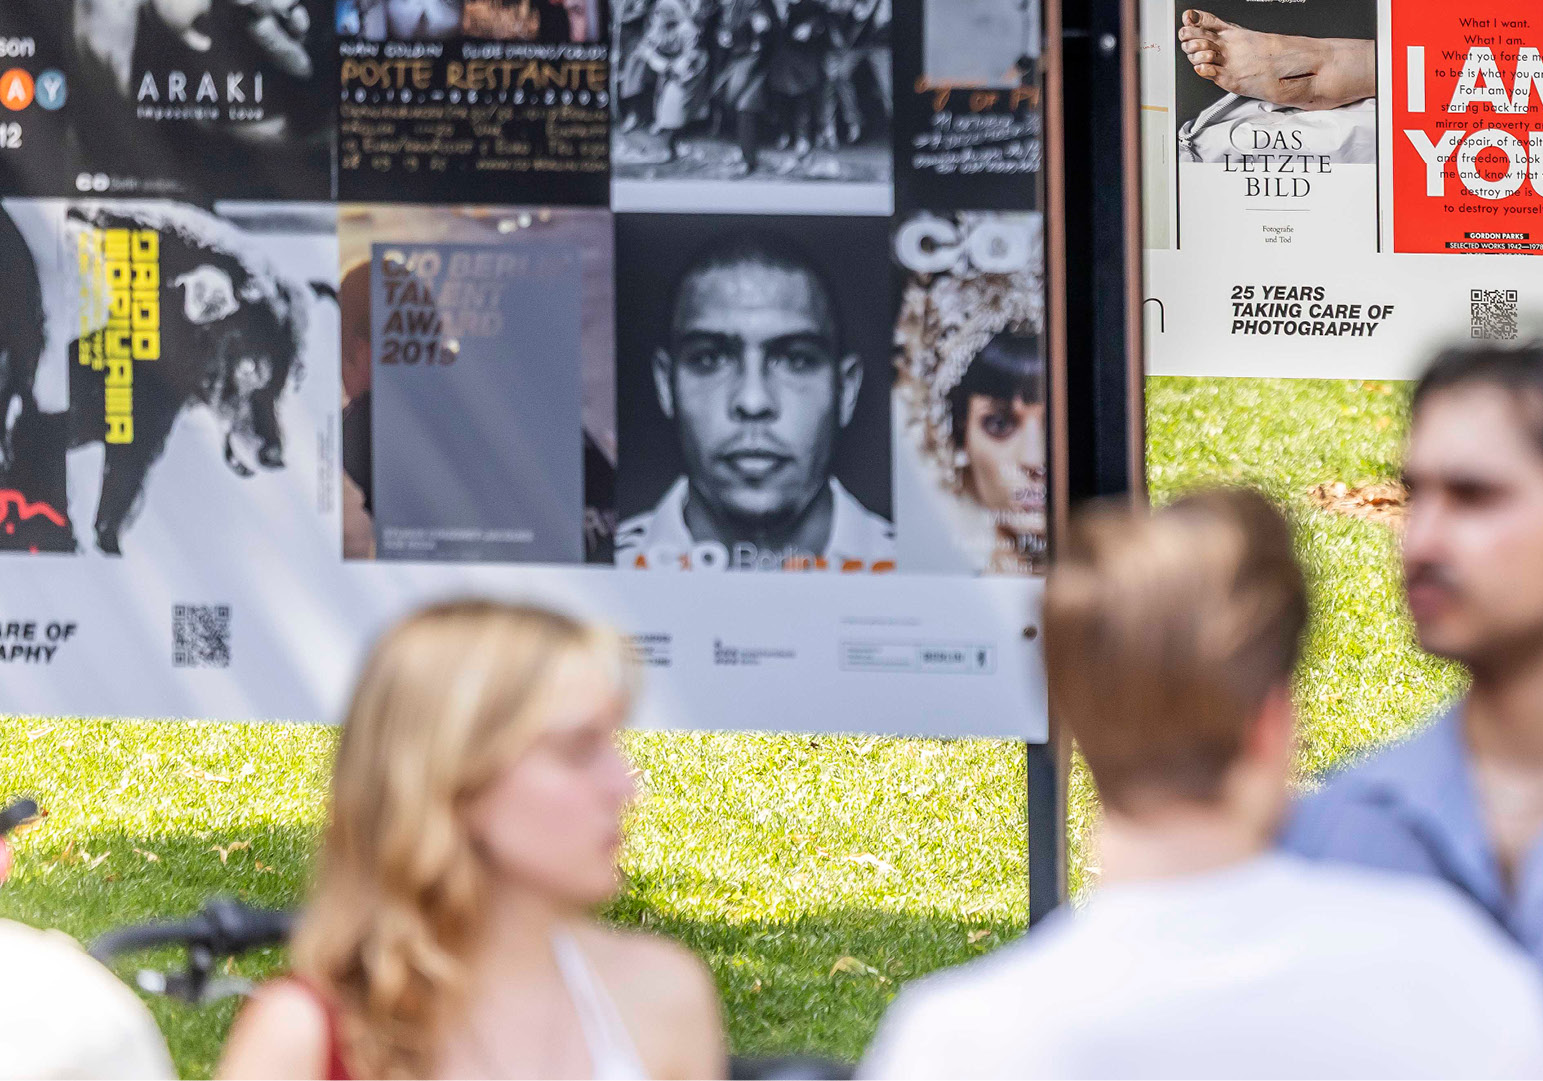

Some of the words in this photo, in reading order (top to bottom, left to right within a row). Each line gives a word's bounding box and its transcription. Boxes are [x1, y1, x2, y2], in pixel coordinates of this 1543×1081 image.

[1459, 17, 1490, 28] What
[1501, 19, 1530, 29] want.
[1463, 35, 1495, 45] What
[1505, 37, 1526, 45] am.
[1441, 50, 1473, 61] What
[1477, 53, 1496, 64] you
[1500, 51, 1528, 62] force
[341, 58, 433, 89] POSTE
[446, 60, 609, 91] RESTANTE
[1406, 45, 1426, 113] I
[1435, 68, 1447, 78] to
[1450, 67, 1464, 78] be
[1481, 68, 1506, 79] what
[1510, 71, 1530, 81] you
[137, 70, 264, 103] ARAKI
[1459, 84, 1477, 95] For
[1487, 88, 1505, 96] am
[1441, 102, 1479, 114] staring
[1483, 102, 1510, 113] back
[1513, 102, 1539, 113] from
[1435, 119, 1469, 129] mirror
[1472, 119, 1484, 129] of
[1488, 120, 1530, 131] poverty
[1251, 129, 1302, 151] DAS
[1448, 135, 1493, 148] despair,
[1512, 136, 1543, 147] revolt
[1223, 154, 1332, 174] LETZTE
[1436, 153, 1458, 164] and
[1461, 153, 1511, 164] freedom.
[1515, 154, 1541, 164] Look
[1439, 171, 1456, 179] me
[1460, 170, 1481, 179] and
[1484, 169, 1513, 180] know
[1516, 170, 1538, 180] that
[1244, 177, 1311, 198] BILD
[1460, 186, 1501, 198] destroy
[1505, 189, 1521, 197] me
[1458, 203, 1499, 215] destroy
[1262, 225, 1294, 235] Fotografie
[1265, 235, 1277, 243] und
[1277, 235, 1292, 244] Tod
[1480, 242, 1506, 250] WORKS
[1231, 285, 1255, 300] 25
[1261, 286, 1326, 302] YEARS
[1232, 302, 1303, 319] TAKING
[1308, 304, 1363, 320] CARE
[1367, 305, 1394, 320] OF
[1231, 320, 1378, 337] PHOTOGRAPHY
